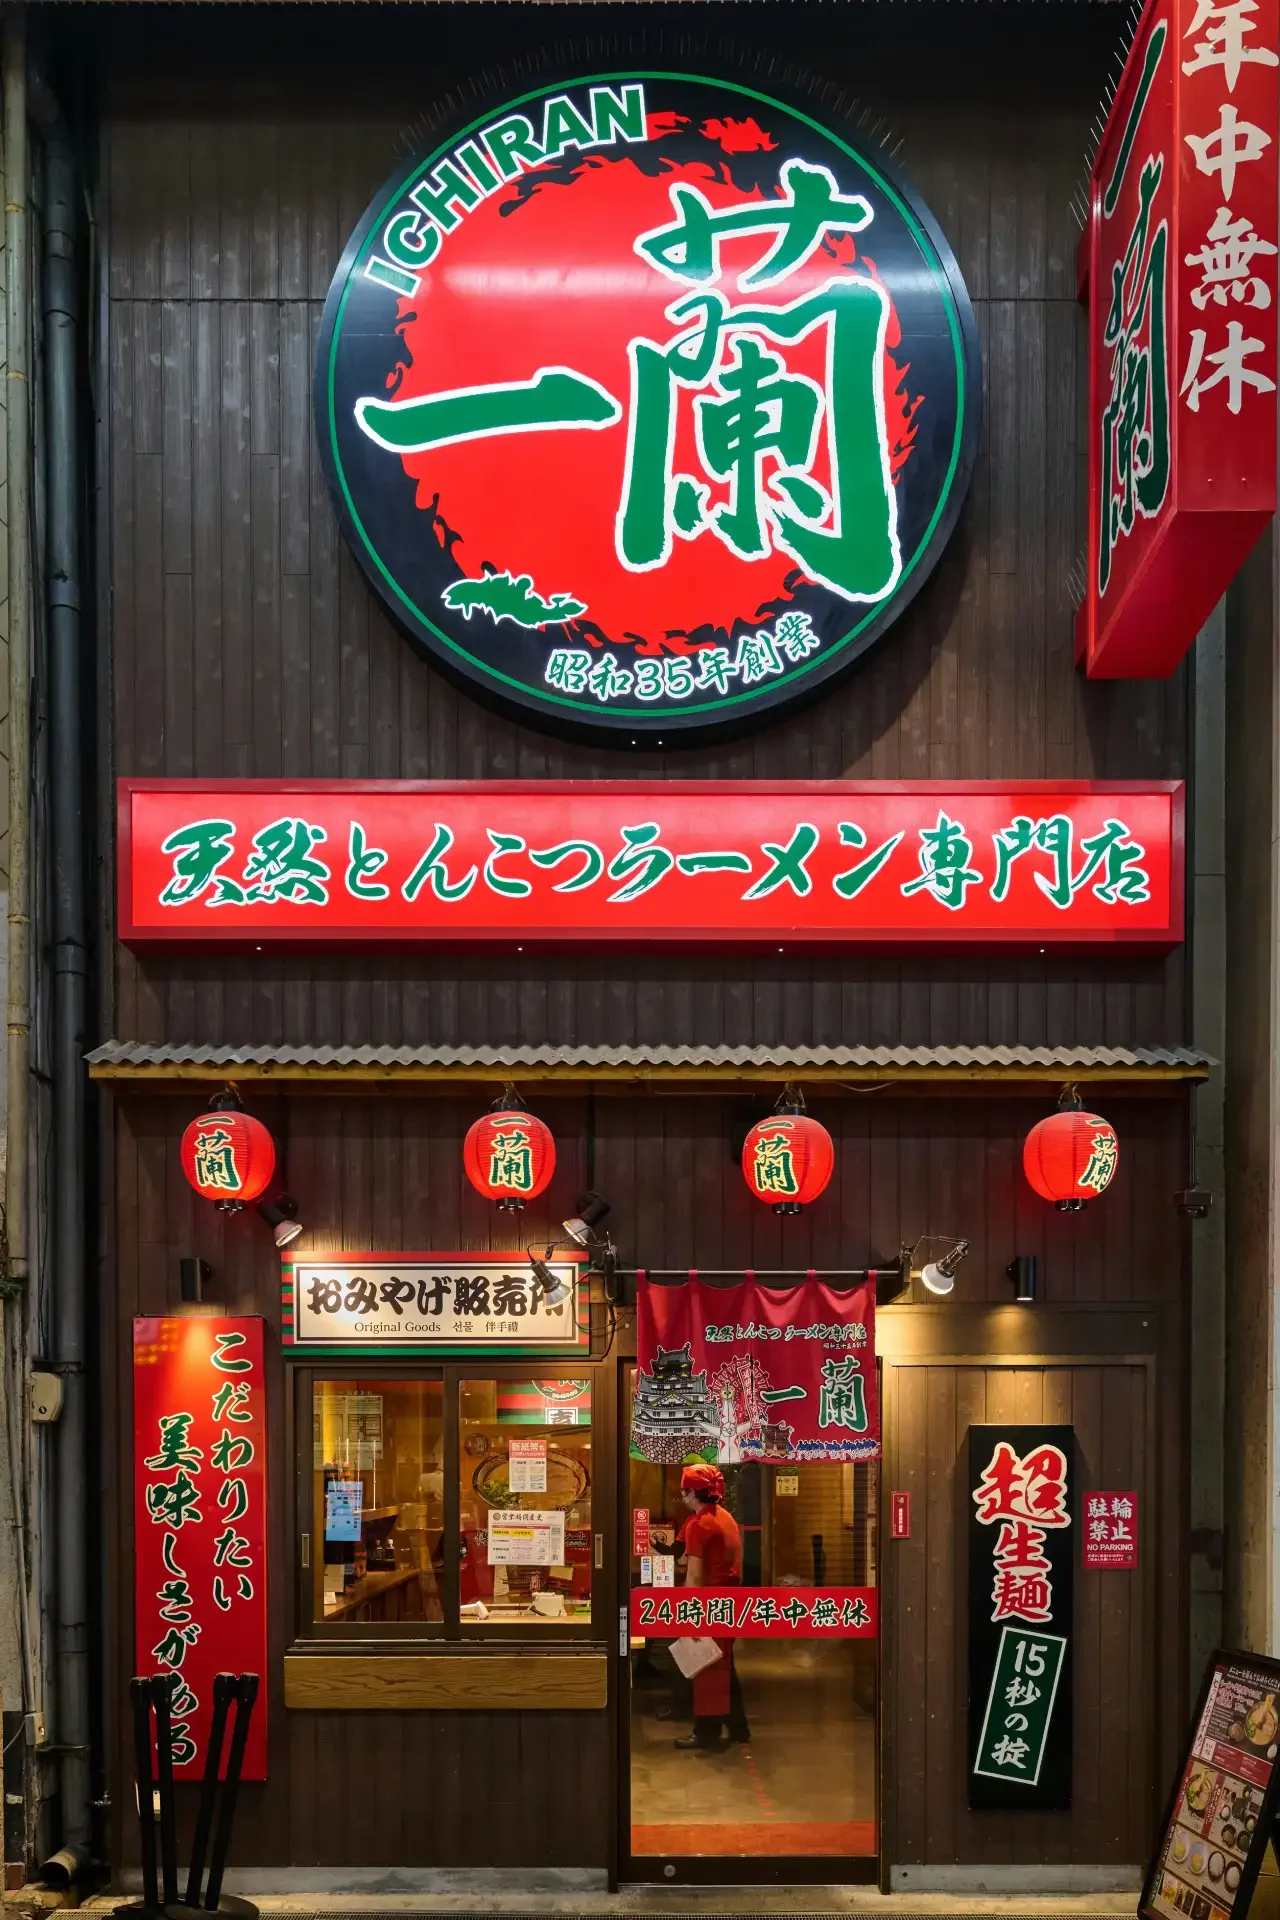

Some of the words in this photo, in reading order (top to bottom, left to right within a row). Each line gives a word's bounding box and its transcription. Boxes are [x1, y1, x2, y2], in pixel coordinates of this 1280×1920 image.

[364, 85, 648, 299] ICHIRAN
[1178, 0, 1280, 416] 年中無休
[1099, 18, 1171, 599] 一蘭
[354, 158, 903, 602] 一蘭
[545, 612, 821, 701] 昭和35年創業
[158, 809, 1152, 911] 天然とんこつラーメン専門店
[194, 1115, 242, 1190] 一蘭
[488, 1116, 533, 1191] 一蘭
[754, 1120, 799, 1195] 一蘭
[1078, 1118, 1119, 1193] 一蘭
[354, 1321, 401, 1334] Original
[405, 1321, 441, 1332] Goods
[452, 1321, 474, 1333] 선물
[485, 1321, 519, 1333] 伴手禮
[760, 1355, 868, 1433] 一蘭
[210, 1333, 255, 1611] こだわりたい
[1087, 1497, 1133, 1519] 駐輪
[972, 1441, 1072, 1623] 超生麺
[1086, 1543, 1099, 1551] NO
[1100, 1543, 1133, 1551] PARKING
[1088, 1520, 1133, 1541] 禁止
[639, 1598, 871, 1629] 24時間/年中無休
[991, 1640, 1048, 1769] 15秒の掟
